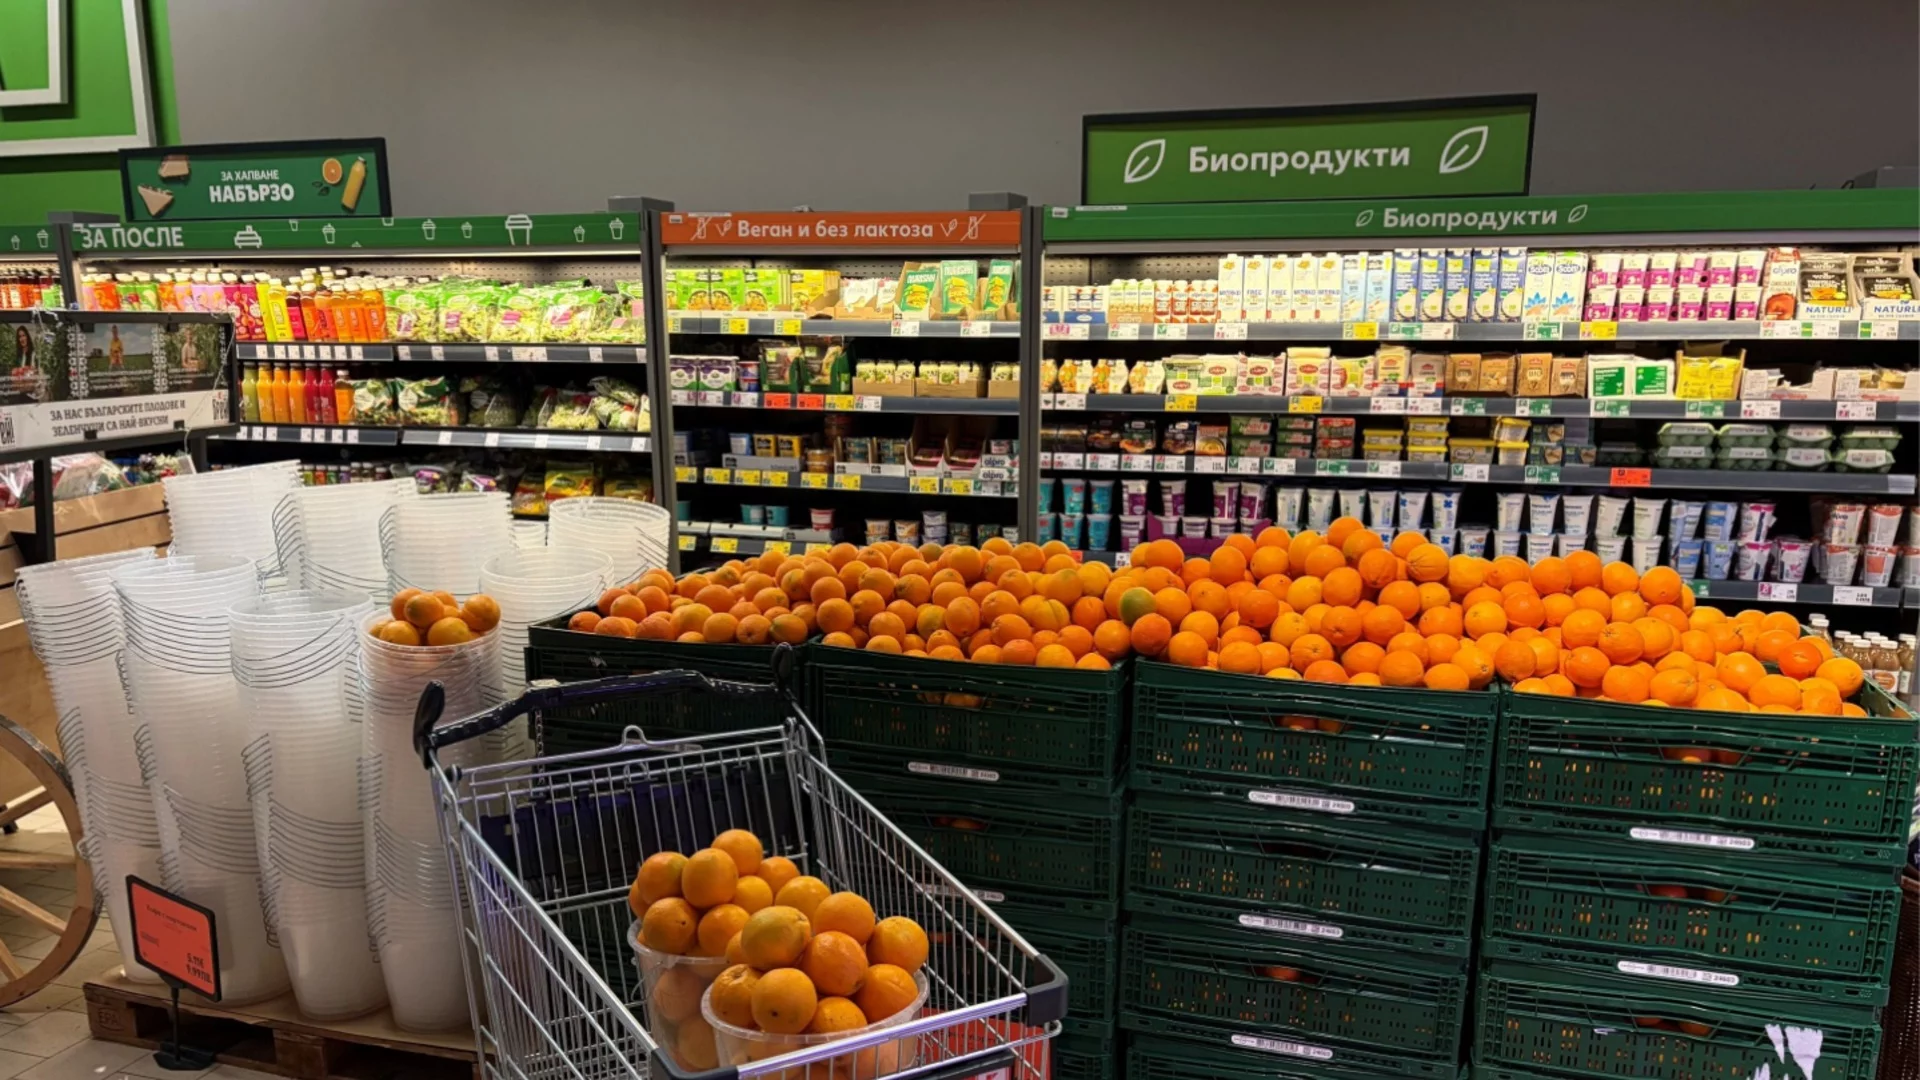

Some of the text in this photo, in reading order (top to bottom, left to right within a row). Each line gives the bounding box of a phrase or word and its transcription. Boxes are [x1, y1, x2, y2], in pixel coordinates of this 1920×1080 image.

[1189, 146, 1410, 177] Биопродукти
[221, 169, 279, 181] ЗА ХАПВАНЕ
[209, 183, 295, 203] НАБЪРЗО
[1383, 207, 1557, 231] Биопродукти
[738, 220, 933, 237] Веган и без лактоза
[81, 226, 184, 249] ЗА ПОСЛЕ
[1773, 267, 1797, 276] alpro
[50, 400, 186, 421] ЗА НАС БЪЛГАРСКИТЕ ПЛОДОВЕ И
[106, 419, 118, 430] СА
[119, 415, 169, 429] НАЙ-ВКУСНИ
[984, 457, 1005, 467] alpro
[983, 470, 1004, 480] alpro
